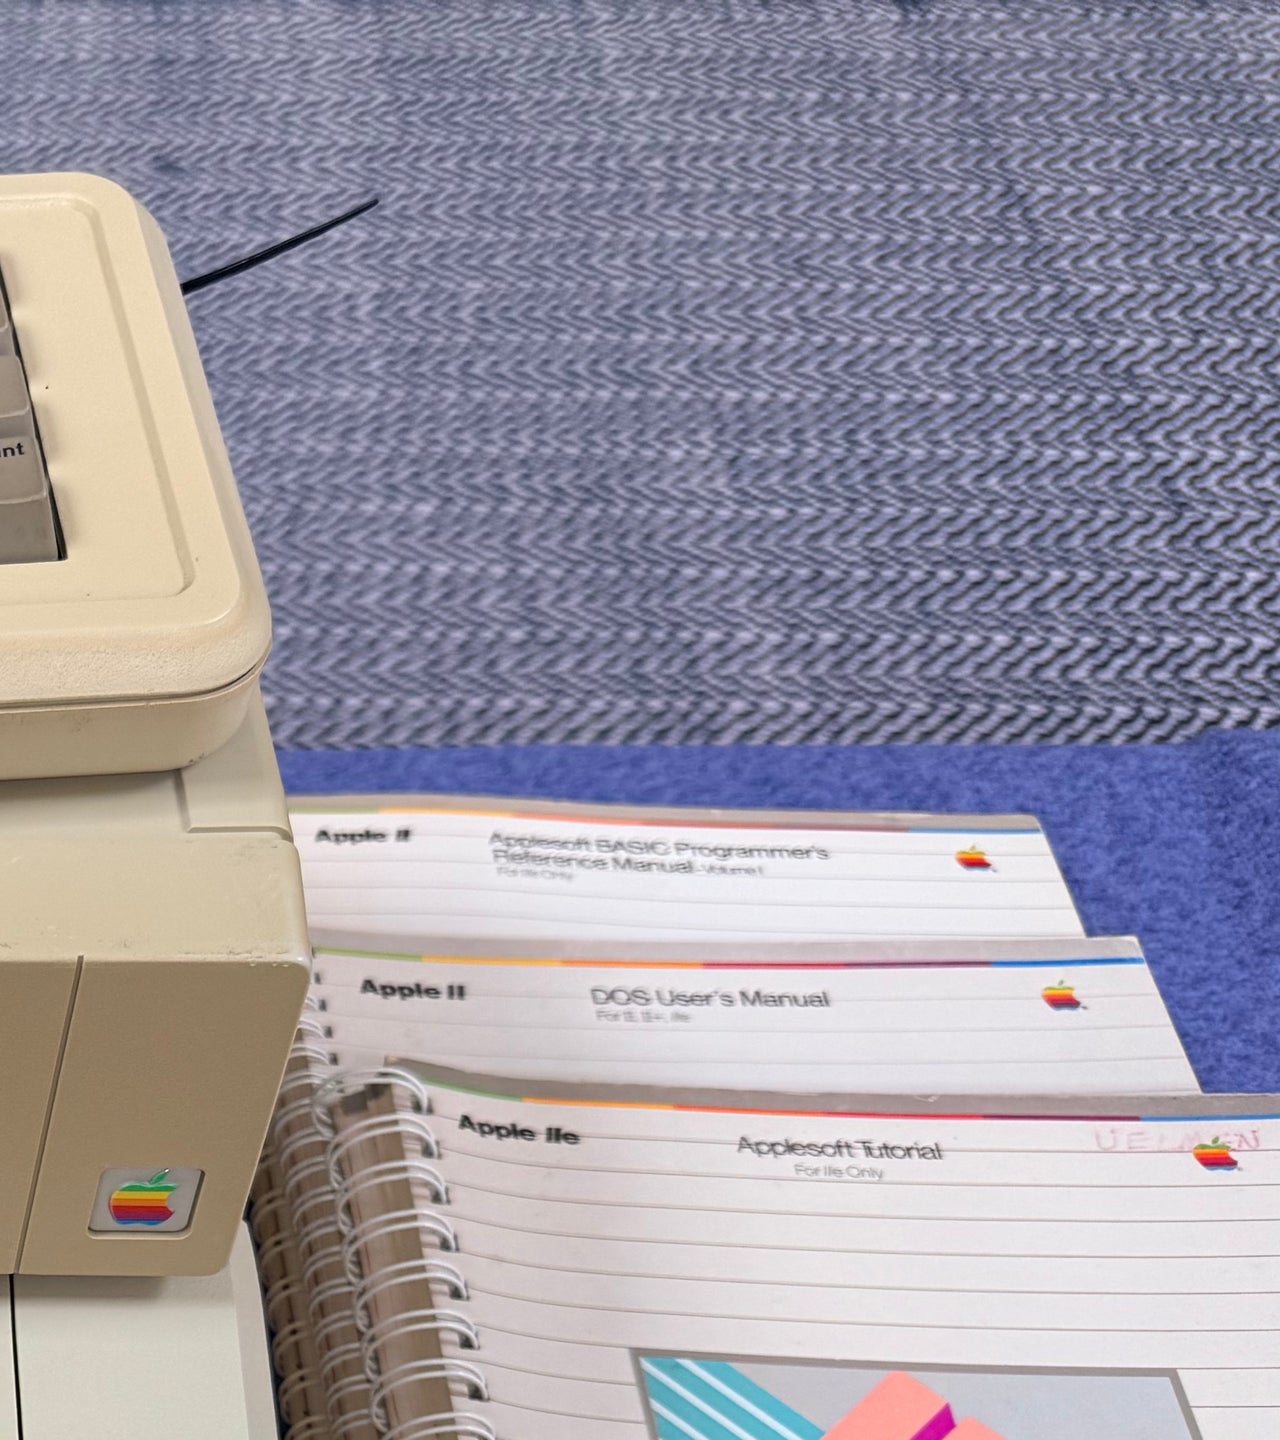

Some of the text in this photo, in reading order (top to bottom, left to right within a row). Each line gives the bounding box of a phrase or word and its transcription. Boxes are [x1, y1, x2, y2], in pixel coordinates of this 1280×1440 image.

[315, 829, 387, 846] Apple
[594, 839, 672, 855] BASIC
[675, 841, 831, 861] Programmer's
[493, 849, 607, 869] Reference
[613, 858, 693, 873] Manual
[360, 979, 442, 999] Apple
[591, 987, 831, 1007] DOS User's Manual
[458, 1114, 535, 1143] Apple
[739, 1136, 944, 1161] Applesoft Tutorial
[794, 1162, 820, 1176] For
[846, 1164, 883, 1180] Only
